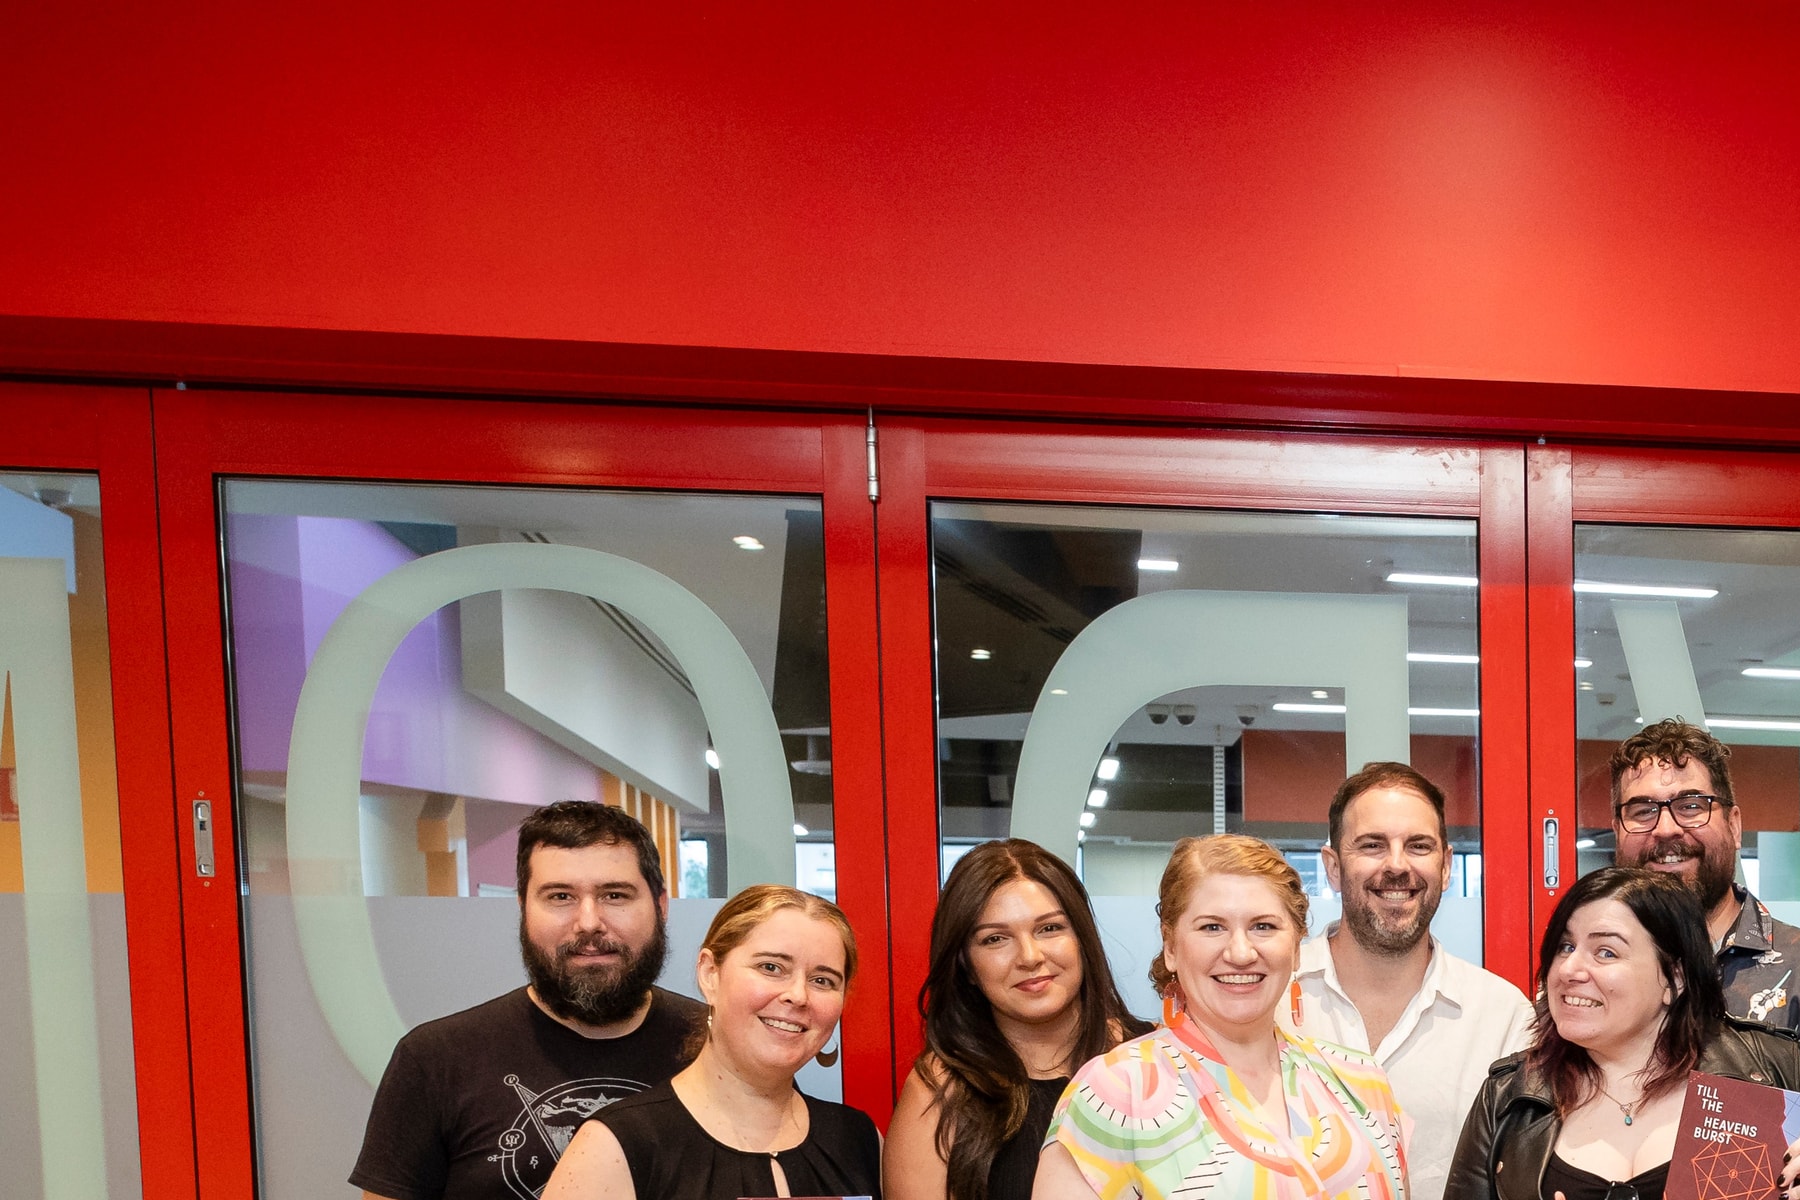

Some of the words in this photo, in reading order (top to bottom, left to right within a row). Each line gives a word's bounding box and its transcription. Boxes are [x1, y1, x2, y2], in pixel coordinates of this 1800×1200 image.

[1696, 1084, 1719, 1100] TILL
[1701, 1099, 1724, 1113] THE
[1693, 1127, 1733, 1145] BURST
[1704, 1117, 1758, 1138] HEAVENS
